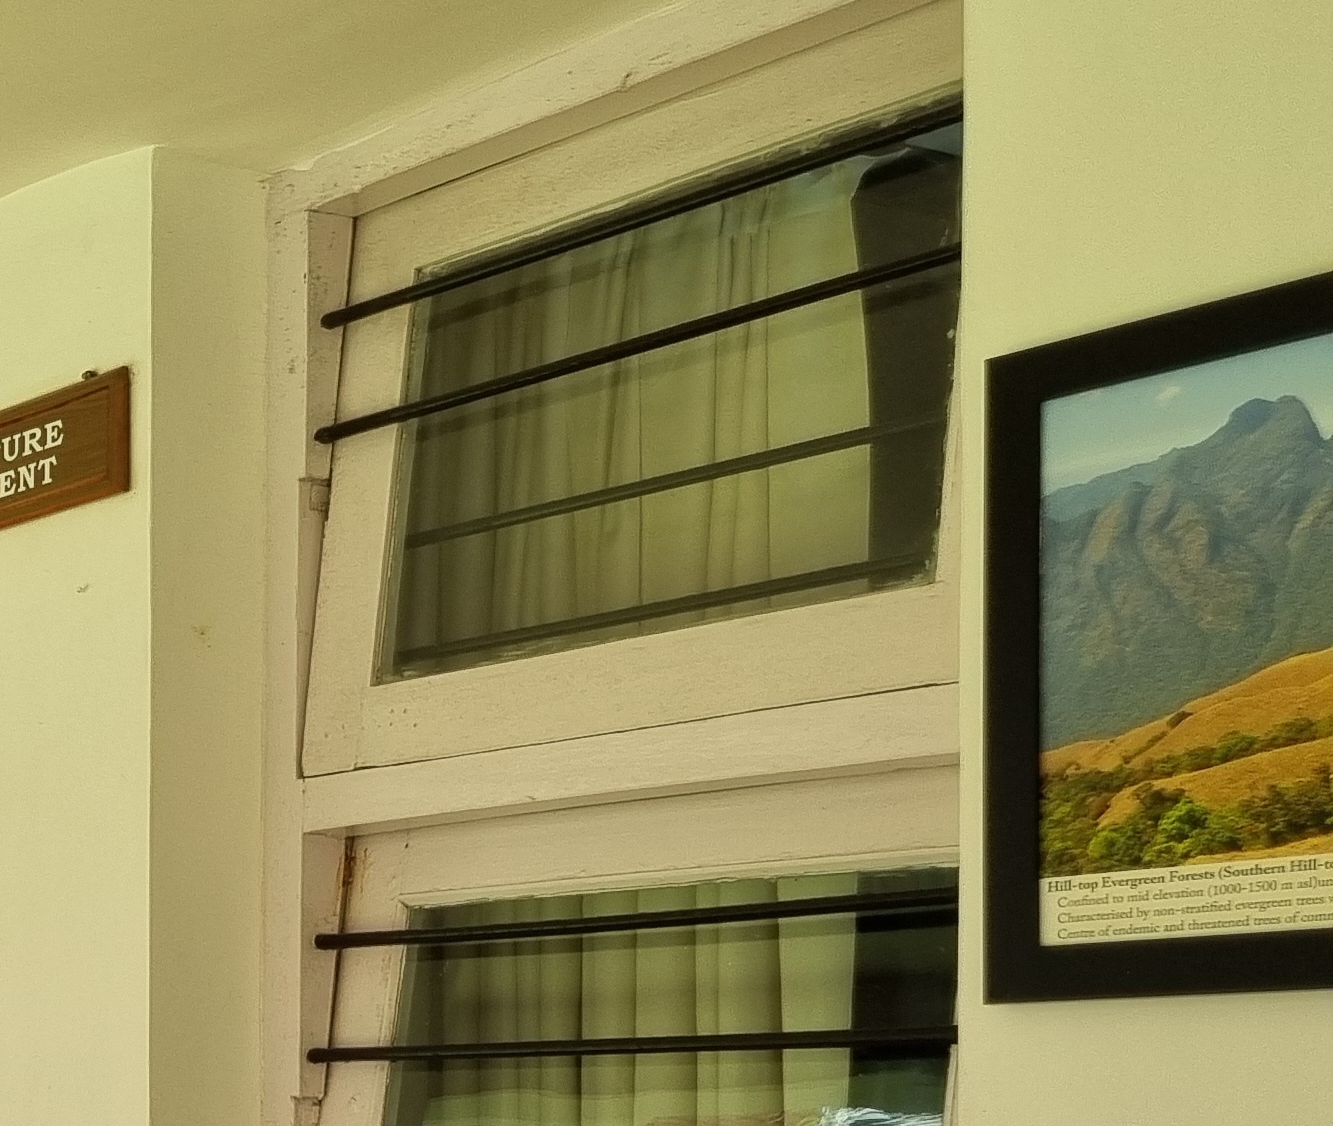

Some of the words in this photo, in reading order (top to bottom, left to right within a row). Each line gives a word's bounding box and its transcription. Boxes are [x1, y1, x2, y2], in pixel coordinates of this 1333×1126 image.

[1047, 879, 1098, 893] Hill-top
[1101, 875, 1165, 890] Evergreen
[1169, 870, 1215, 882] Forests
[1218, 863, 1286, 880] (Southern
[1057, 894, 1110, 908] Confined
[1112, 896, 1124, 904] to
[1127, 889, 1150, 902] mid
[1152, 887, 1204, 901] elevation
[1207, 879, 1278, 898] (1000-1500
[1057, 907, 1133, 924] Characterised
[1136, 906, 1151, 921] by
[1153, 900, 1232, 917] non-stratified
[1235, 899, 1292, 912] evergreen
[1295, 896, 1325, 906] trees
[1057, 928, 1096, 940] Centre
[1097, 924, 1112, 937] of
[1113, 923, 1160, 936] endemic
[1163, 919, 1184, 932] and
[1187, 915, 1250, 931] threatened
[1253, 915, 1281, 926] trees
[1284, 911, 1301, 924] of
